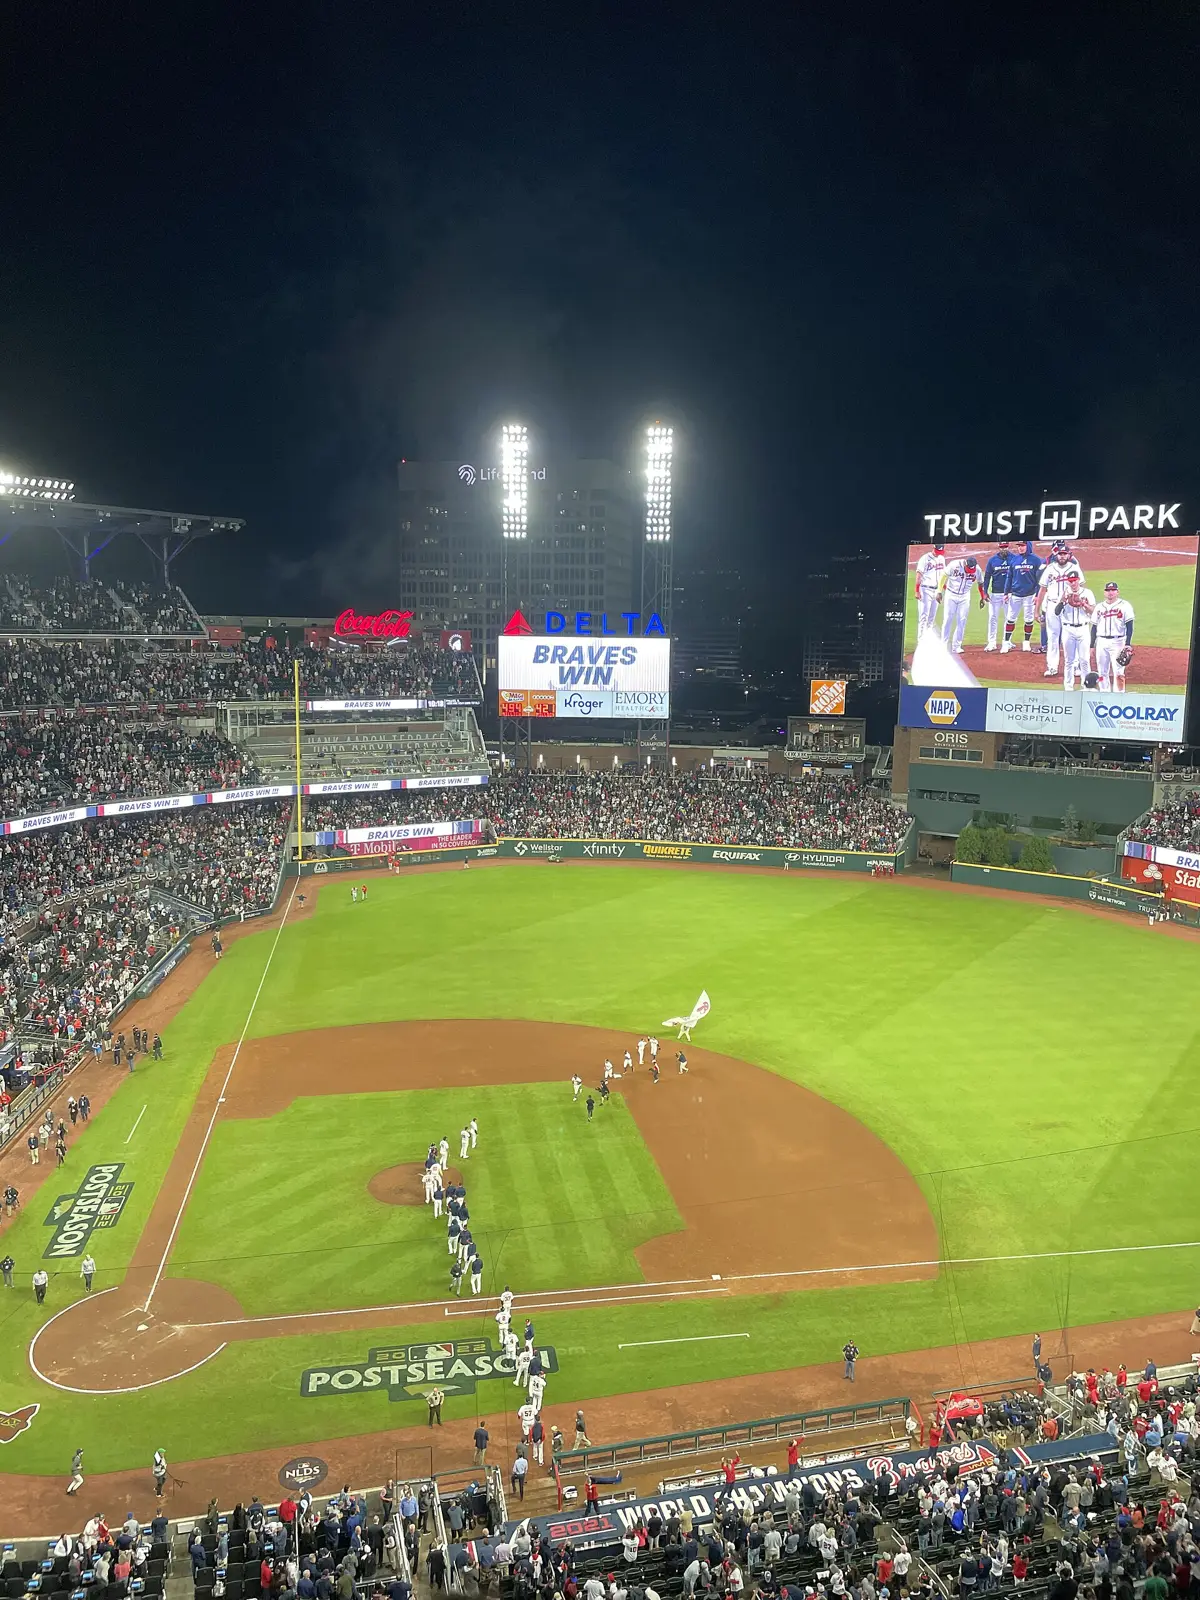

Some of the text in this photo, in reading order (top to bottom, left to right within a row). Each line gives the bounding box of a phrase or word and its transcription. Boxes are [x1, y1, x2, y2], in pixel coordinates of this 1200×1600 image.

[924, 503, 1181, 538] TRUIST PARK
[546, 611, 666, 635] DELTA
[532, 644, 638, 666] BRAVES
[557, 665, 615, 685] WIN
[616, 692, 667, 704] EMORY
[810, 681, 846, 713] HOME
[502, 703, 522, 713] 494
[565, 693, 604, 715] Kroger
[930, 700, 955, 715] NAPA
[994, 703, 1073, 715] NORTHSIDE
[1008, 715, 1057, 723] HOSPITAL
[1095, 705, 1179, 721] COOLRAY
[934, 732, 968, 744] ORIS
[322, 784, 352, 792] BRAVES
[225, 791, 255, 800] BRAVES
[118, 802, 151, 812] BRAVES
[22, 816, 51, 829] BRAVES
[53, 813, 67, 824] WIN
[367, 827, 434, 840] BRAVES WIN
[362, 841, 400, 854] Mobil
[530, 843, 563, 851] Wellstar
[583, 843, 626, 857] xfinity
[643, 845, 693, 856] QUIKRETE
[712, 850, 761, 861] EQUIFAX
[802, 854, 845, 863] HYUNDAI
[49, 1165, 119, 1256] POSTSEASON
[457, 1344, 485, 1353] 22
[376, 1352, 405, 1362] 20
[285, 1465, 320, 1479] NLDS
[550, 1517, 614, 1538] 2021
